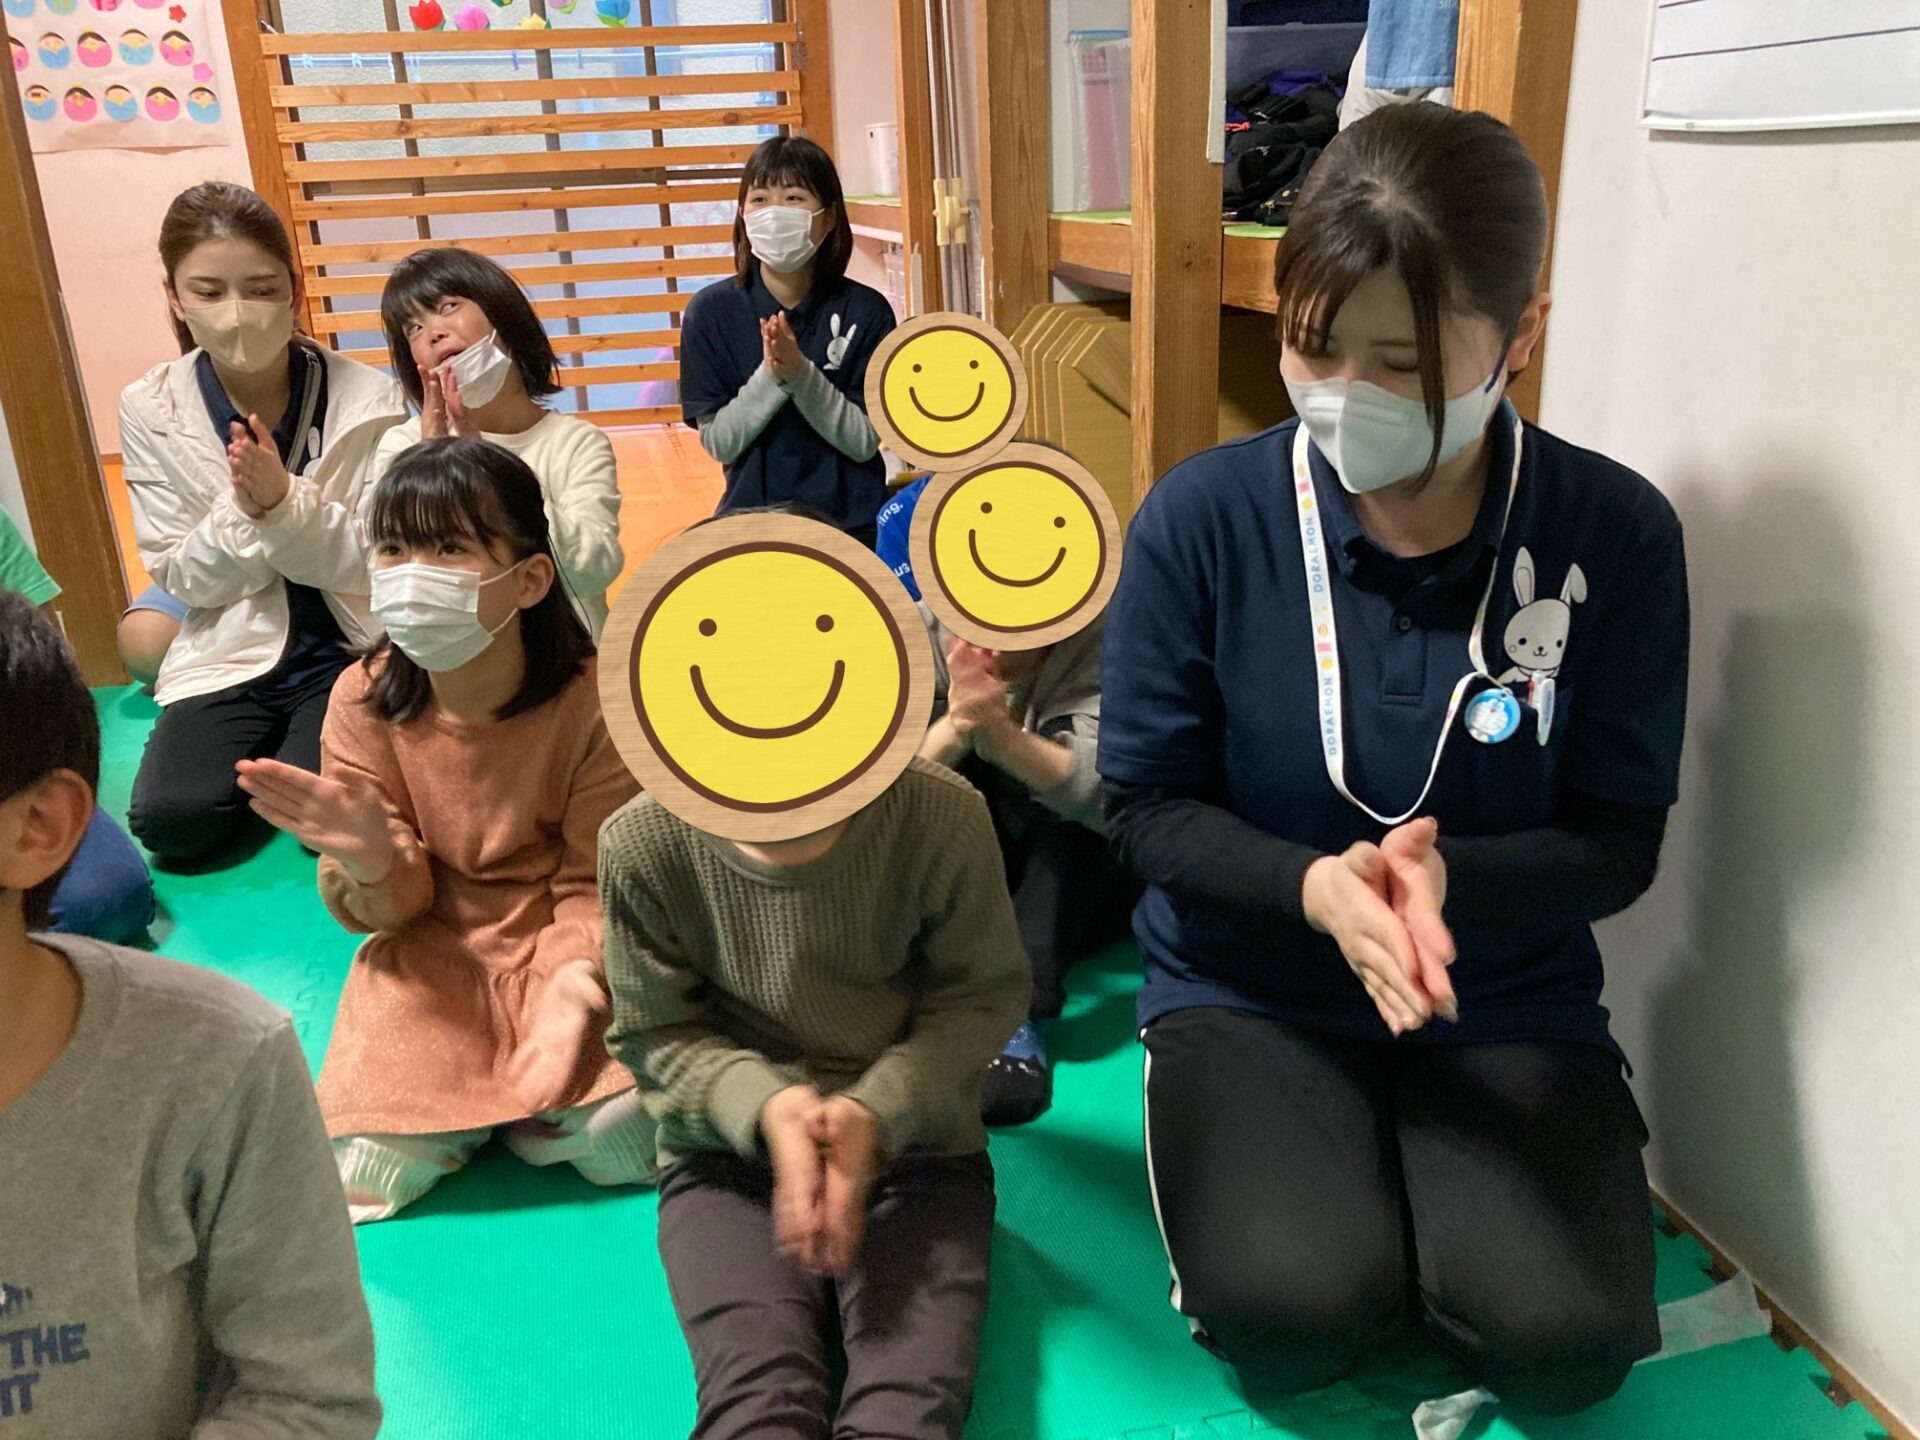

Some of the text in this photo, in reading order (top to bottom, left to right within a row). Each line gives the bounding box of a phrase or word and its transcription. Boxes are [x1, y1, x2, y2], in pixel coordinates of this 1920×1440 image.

[1305, 517, 1323, 592] DORAEMON
[1323, 677, 1338, 755] DORAEMON
[0, 1322, 90, 1369] THE
